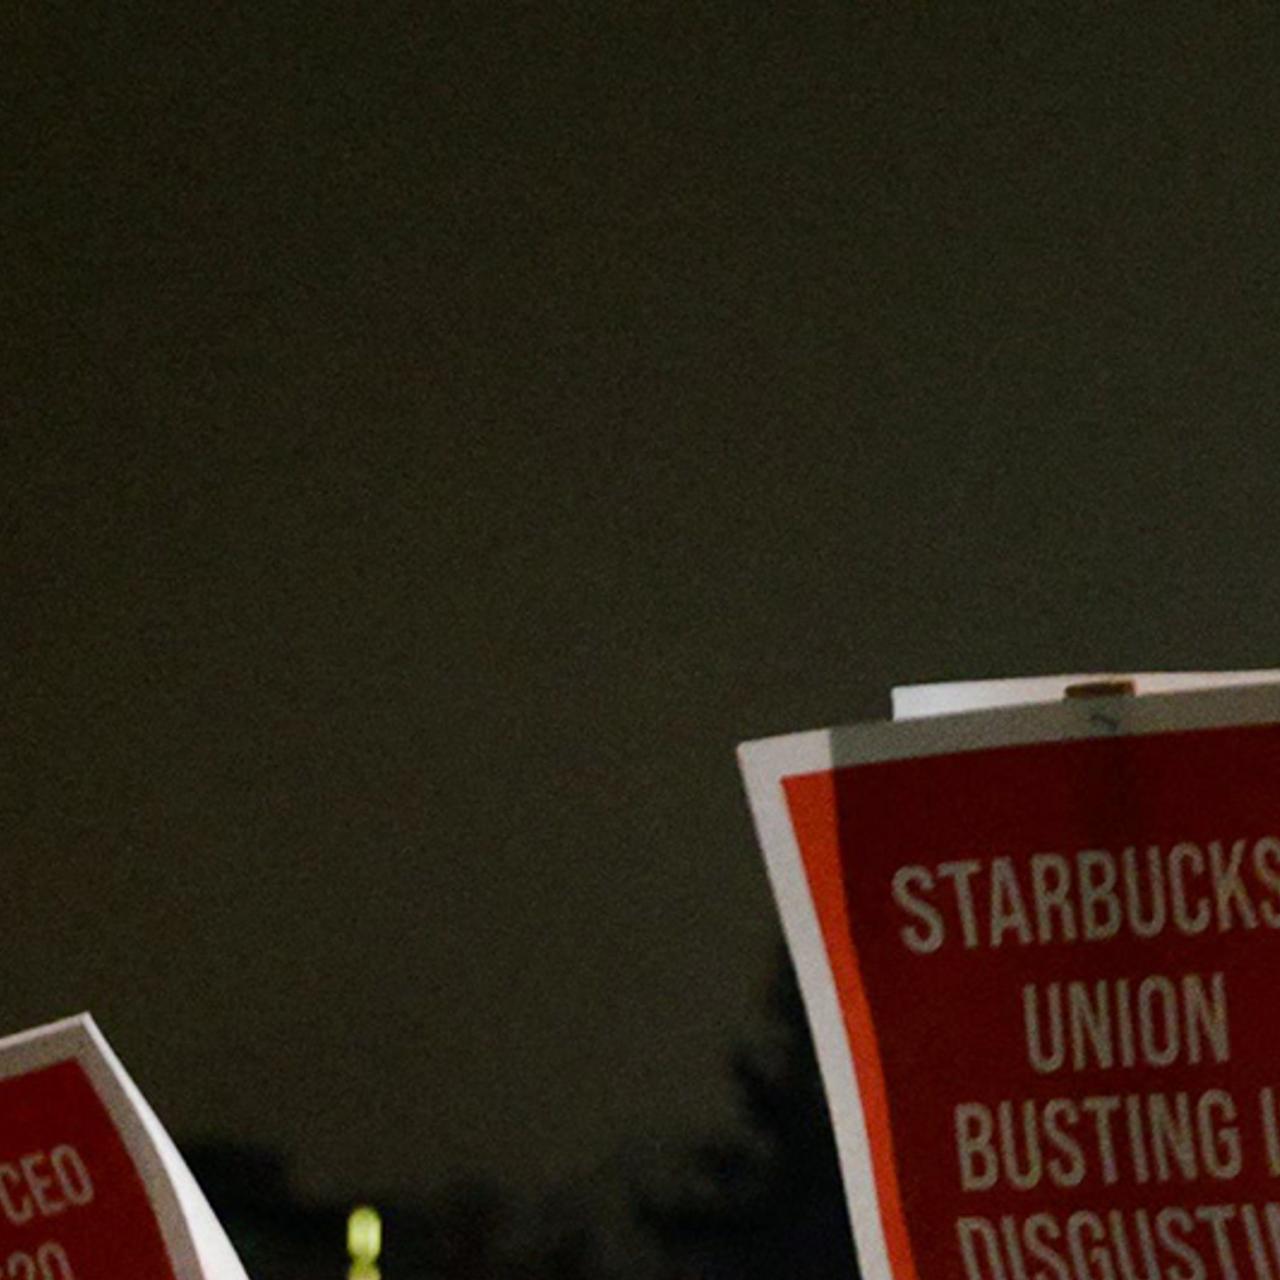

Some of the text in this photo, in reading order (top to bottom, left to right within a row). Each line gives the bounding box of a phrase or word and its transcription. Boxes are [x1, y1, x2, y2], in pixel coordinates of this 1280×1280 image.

[1023, 972, 1230, 1073] UNION
[0, 1143, 94, 1224] CEO
[954, 1089, 1242, 1192] BUSTING
